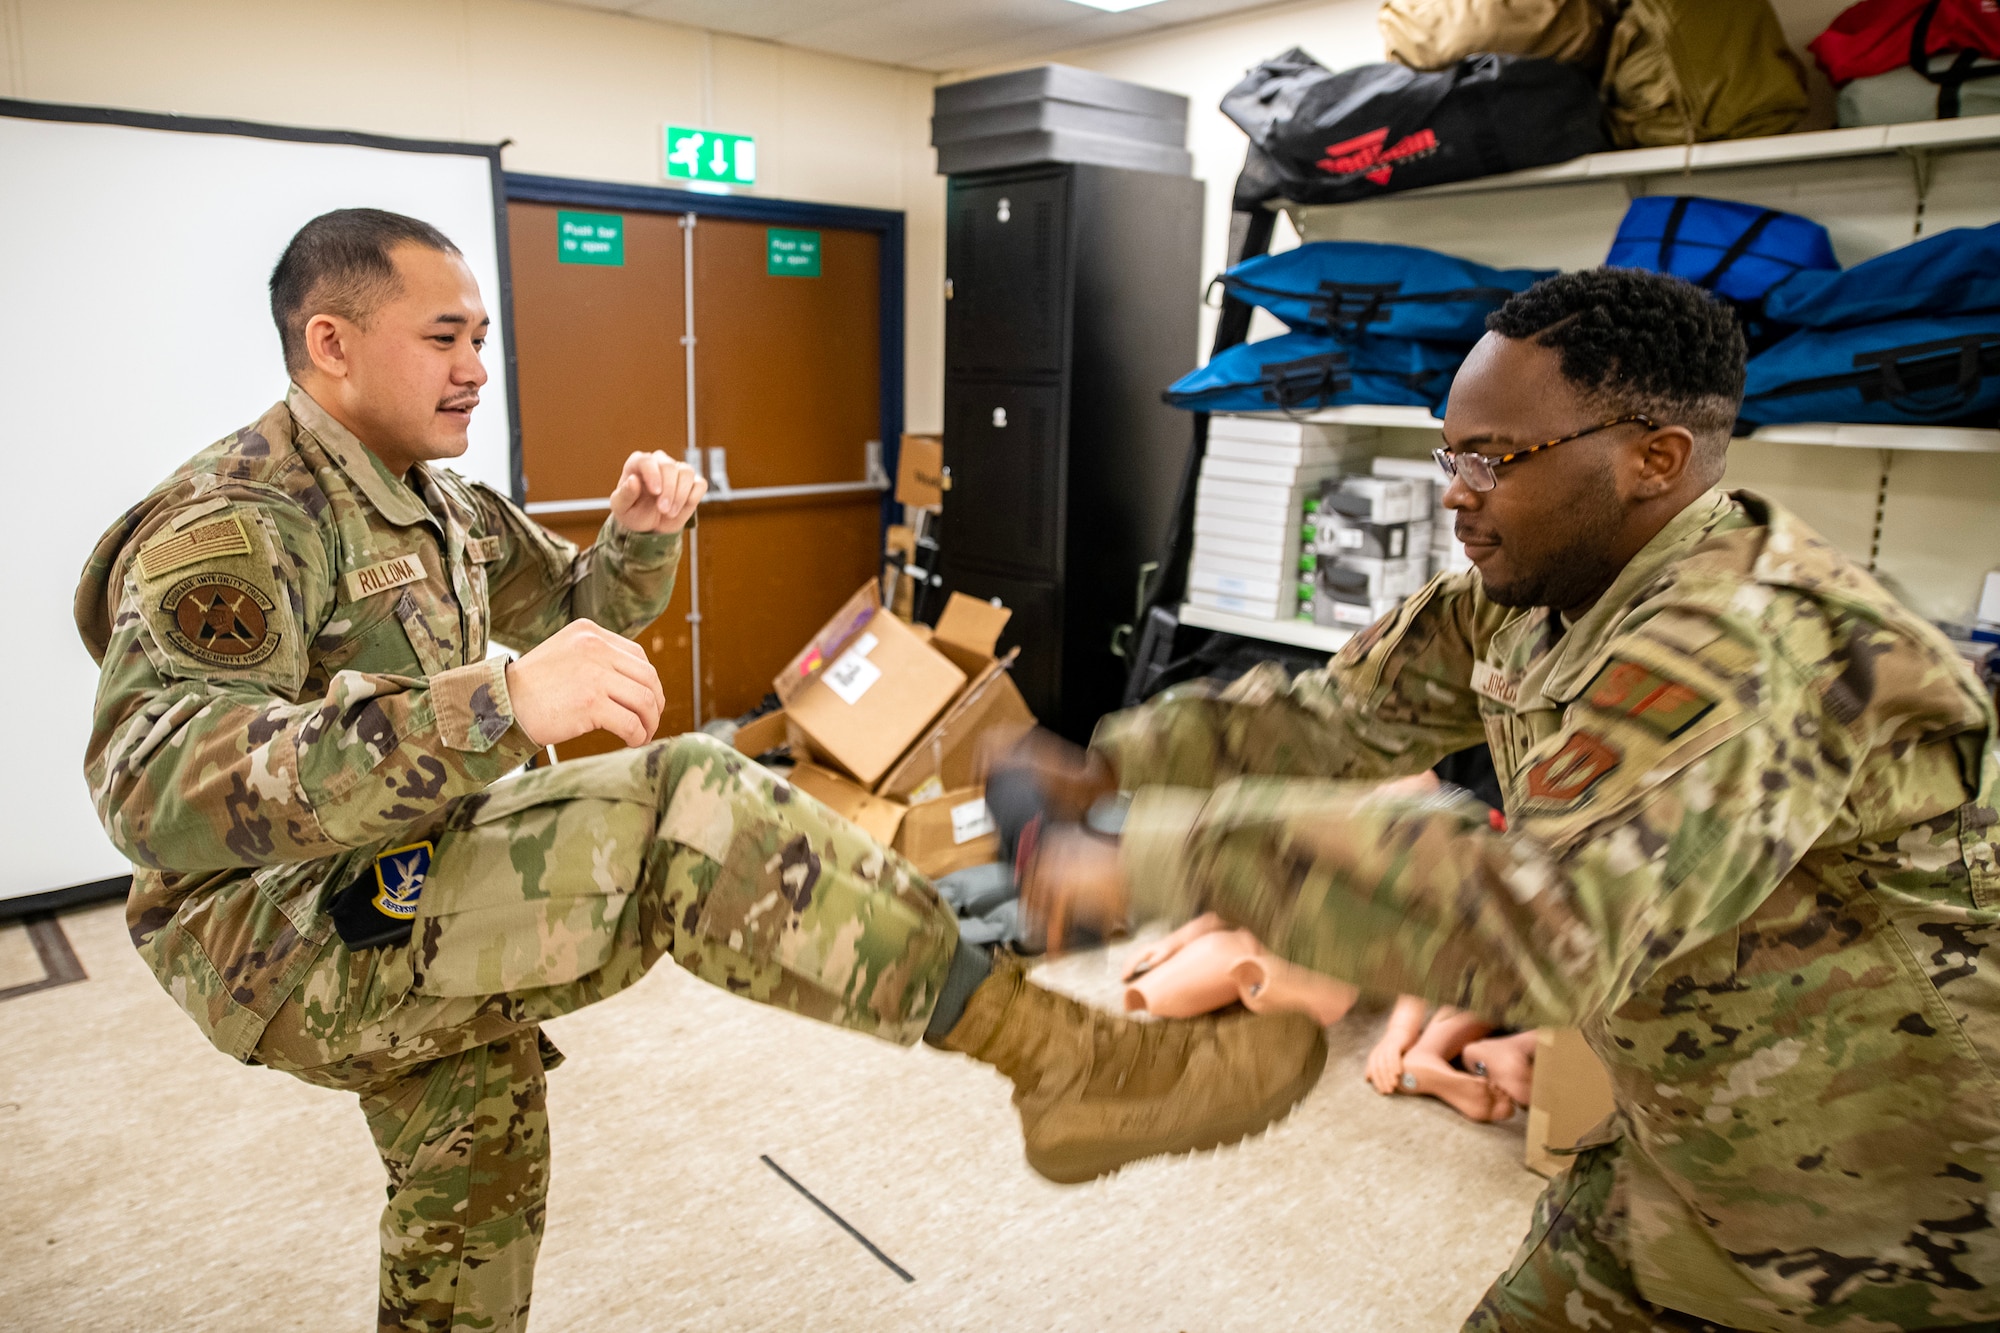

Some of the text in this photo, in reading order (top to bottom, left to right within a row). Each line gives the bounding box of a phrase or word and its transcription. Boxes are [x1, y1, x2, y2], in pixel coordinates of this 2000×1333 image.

[166, 574, 268, 608] COURAGE INTEGRITY TRUTH
[358, 559, 416, 593] RILLONA
[195, 648, 240, 663] SECURITY
